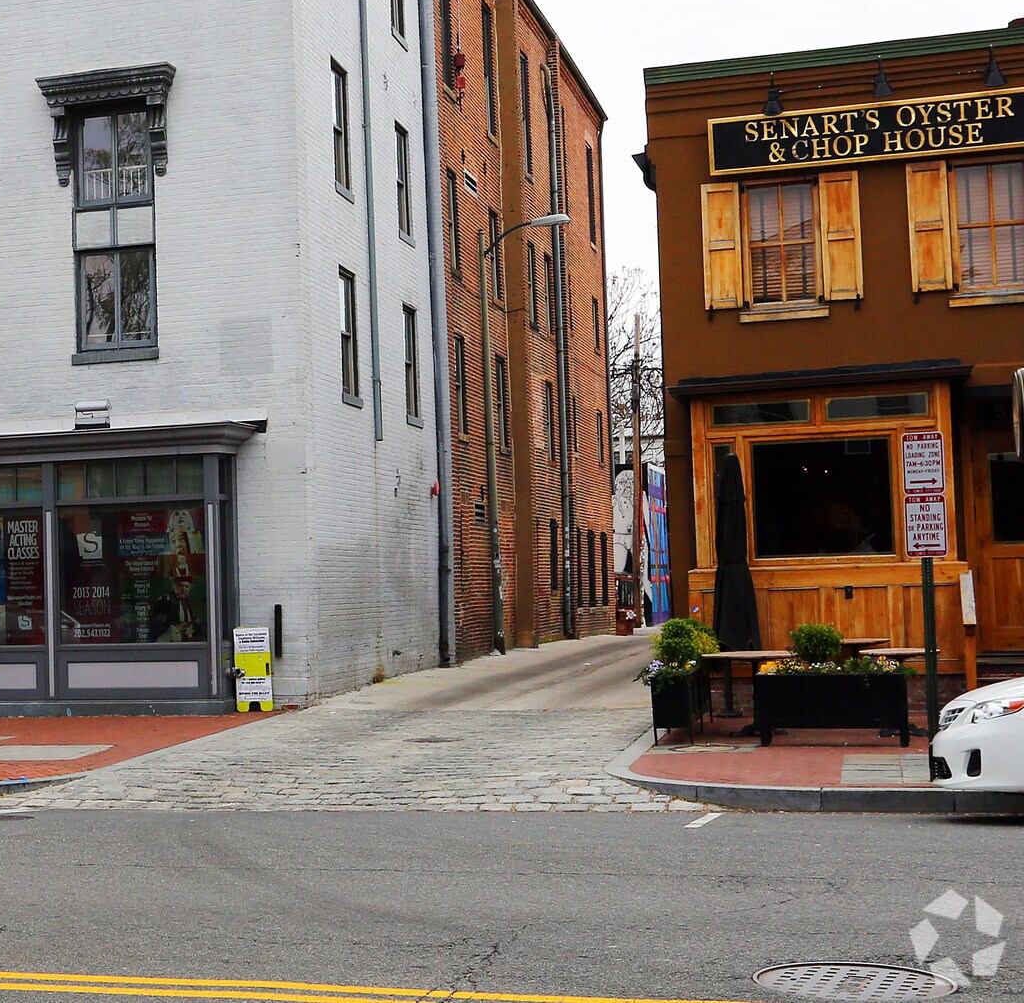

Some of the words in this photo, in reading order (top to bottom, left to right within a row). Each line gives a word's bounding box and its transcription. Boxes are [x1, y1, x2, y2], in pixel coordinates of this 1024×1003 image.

[744, 109, 881, 143] SENART'S
[896, 97, 1015, 126] OYSTER
[768, 141, 786, 163] &
[791, 133, 869, 160] CHOP
[883, 122, 984, 152] HOUSE
[920, 504, 930, 512] NO
[910, 514, 941, 522] STANDING
[7, 520, 38, 534] MASTER
[916, 523, 944, 532] PARKING
[10, 534, 36, 546] ACTING
[912, 532, 940, 541] ANYTIME
[8, 547, 40, 560] CLASSES
[72, 587, 90, 598] 2013
[92, 586, 110, 598] 2014
[74, 599, 111, 616] SEASON
